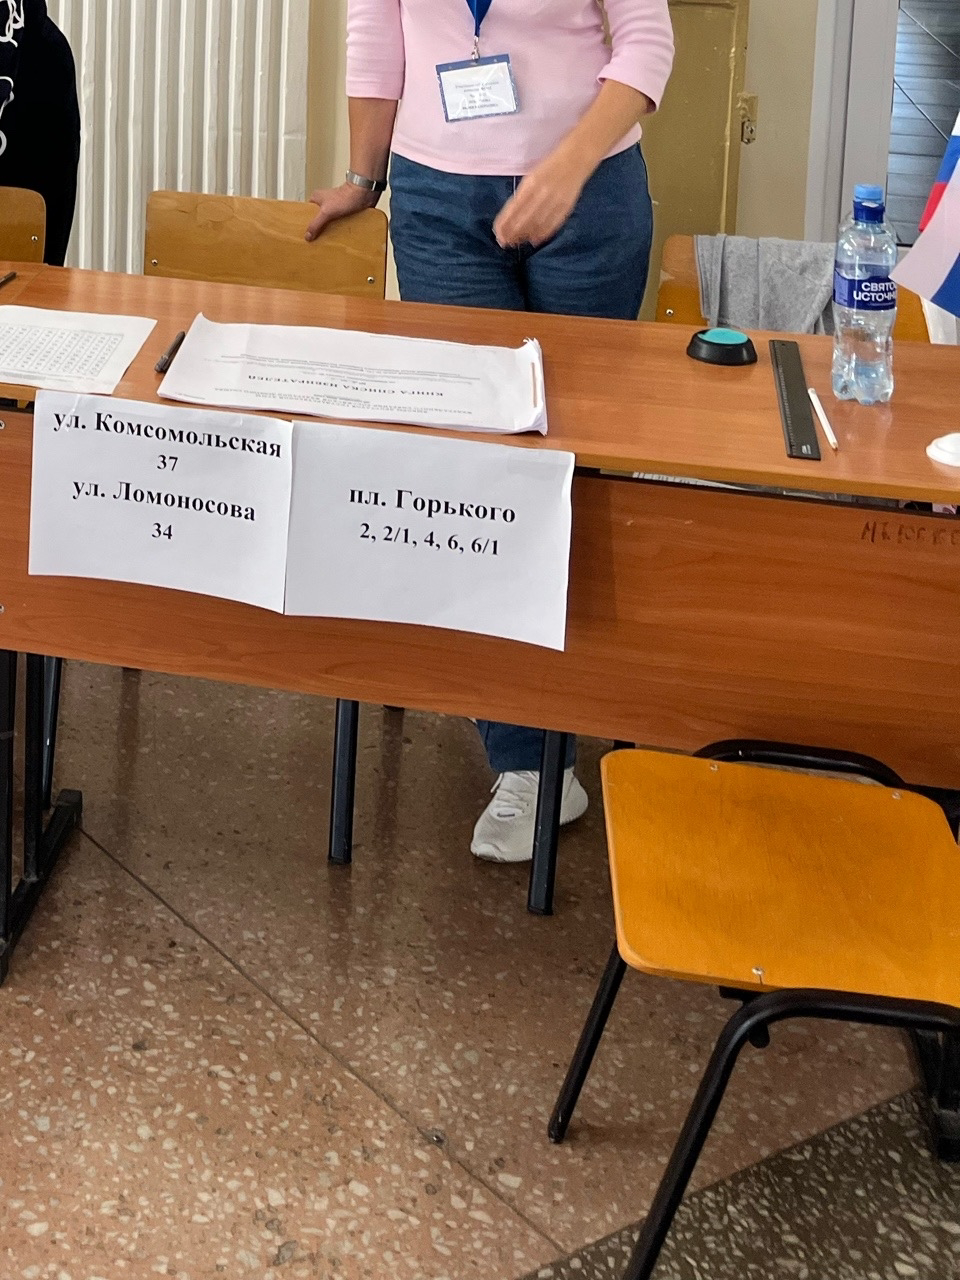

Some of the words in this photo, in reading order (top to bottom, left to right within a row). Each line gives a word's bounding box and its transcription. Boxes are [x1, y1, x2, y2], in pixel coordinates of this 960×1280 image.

[53, 412, 86, 432] ул.
[95, 412, 282, 458] Комсомольская
[156, 454, 179, 472] 37
[72, 481, 106, 500] ул.
[112, 481, 256, 522] Ломоносова
[350, 488, 386, 507] пл.
[396, 489, 516, 524] Горького
[152, 522, 174, 540] 34
[360, 523, 376, 542] 2,
[383, 526, 418, 548] 2/1,
[424, 531, 441, 551] 4,
[448, 534, 464, 554] 6,
[471, 537, 499, 556] 6/1
